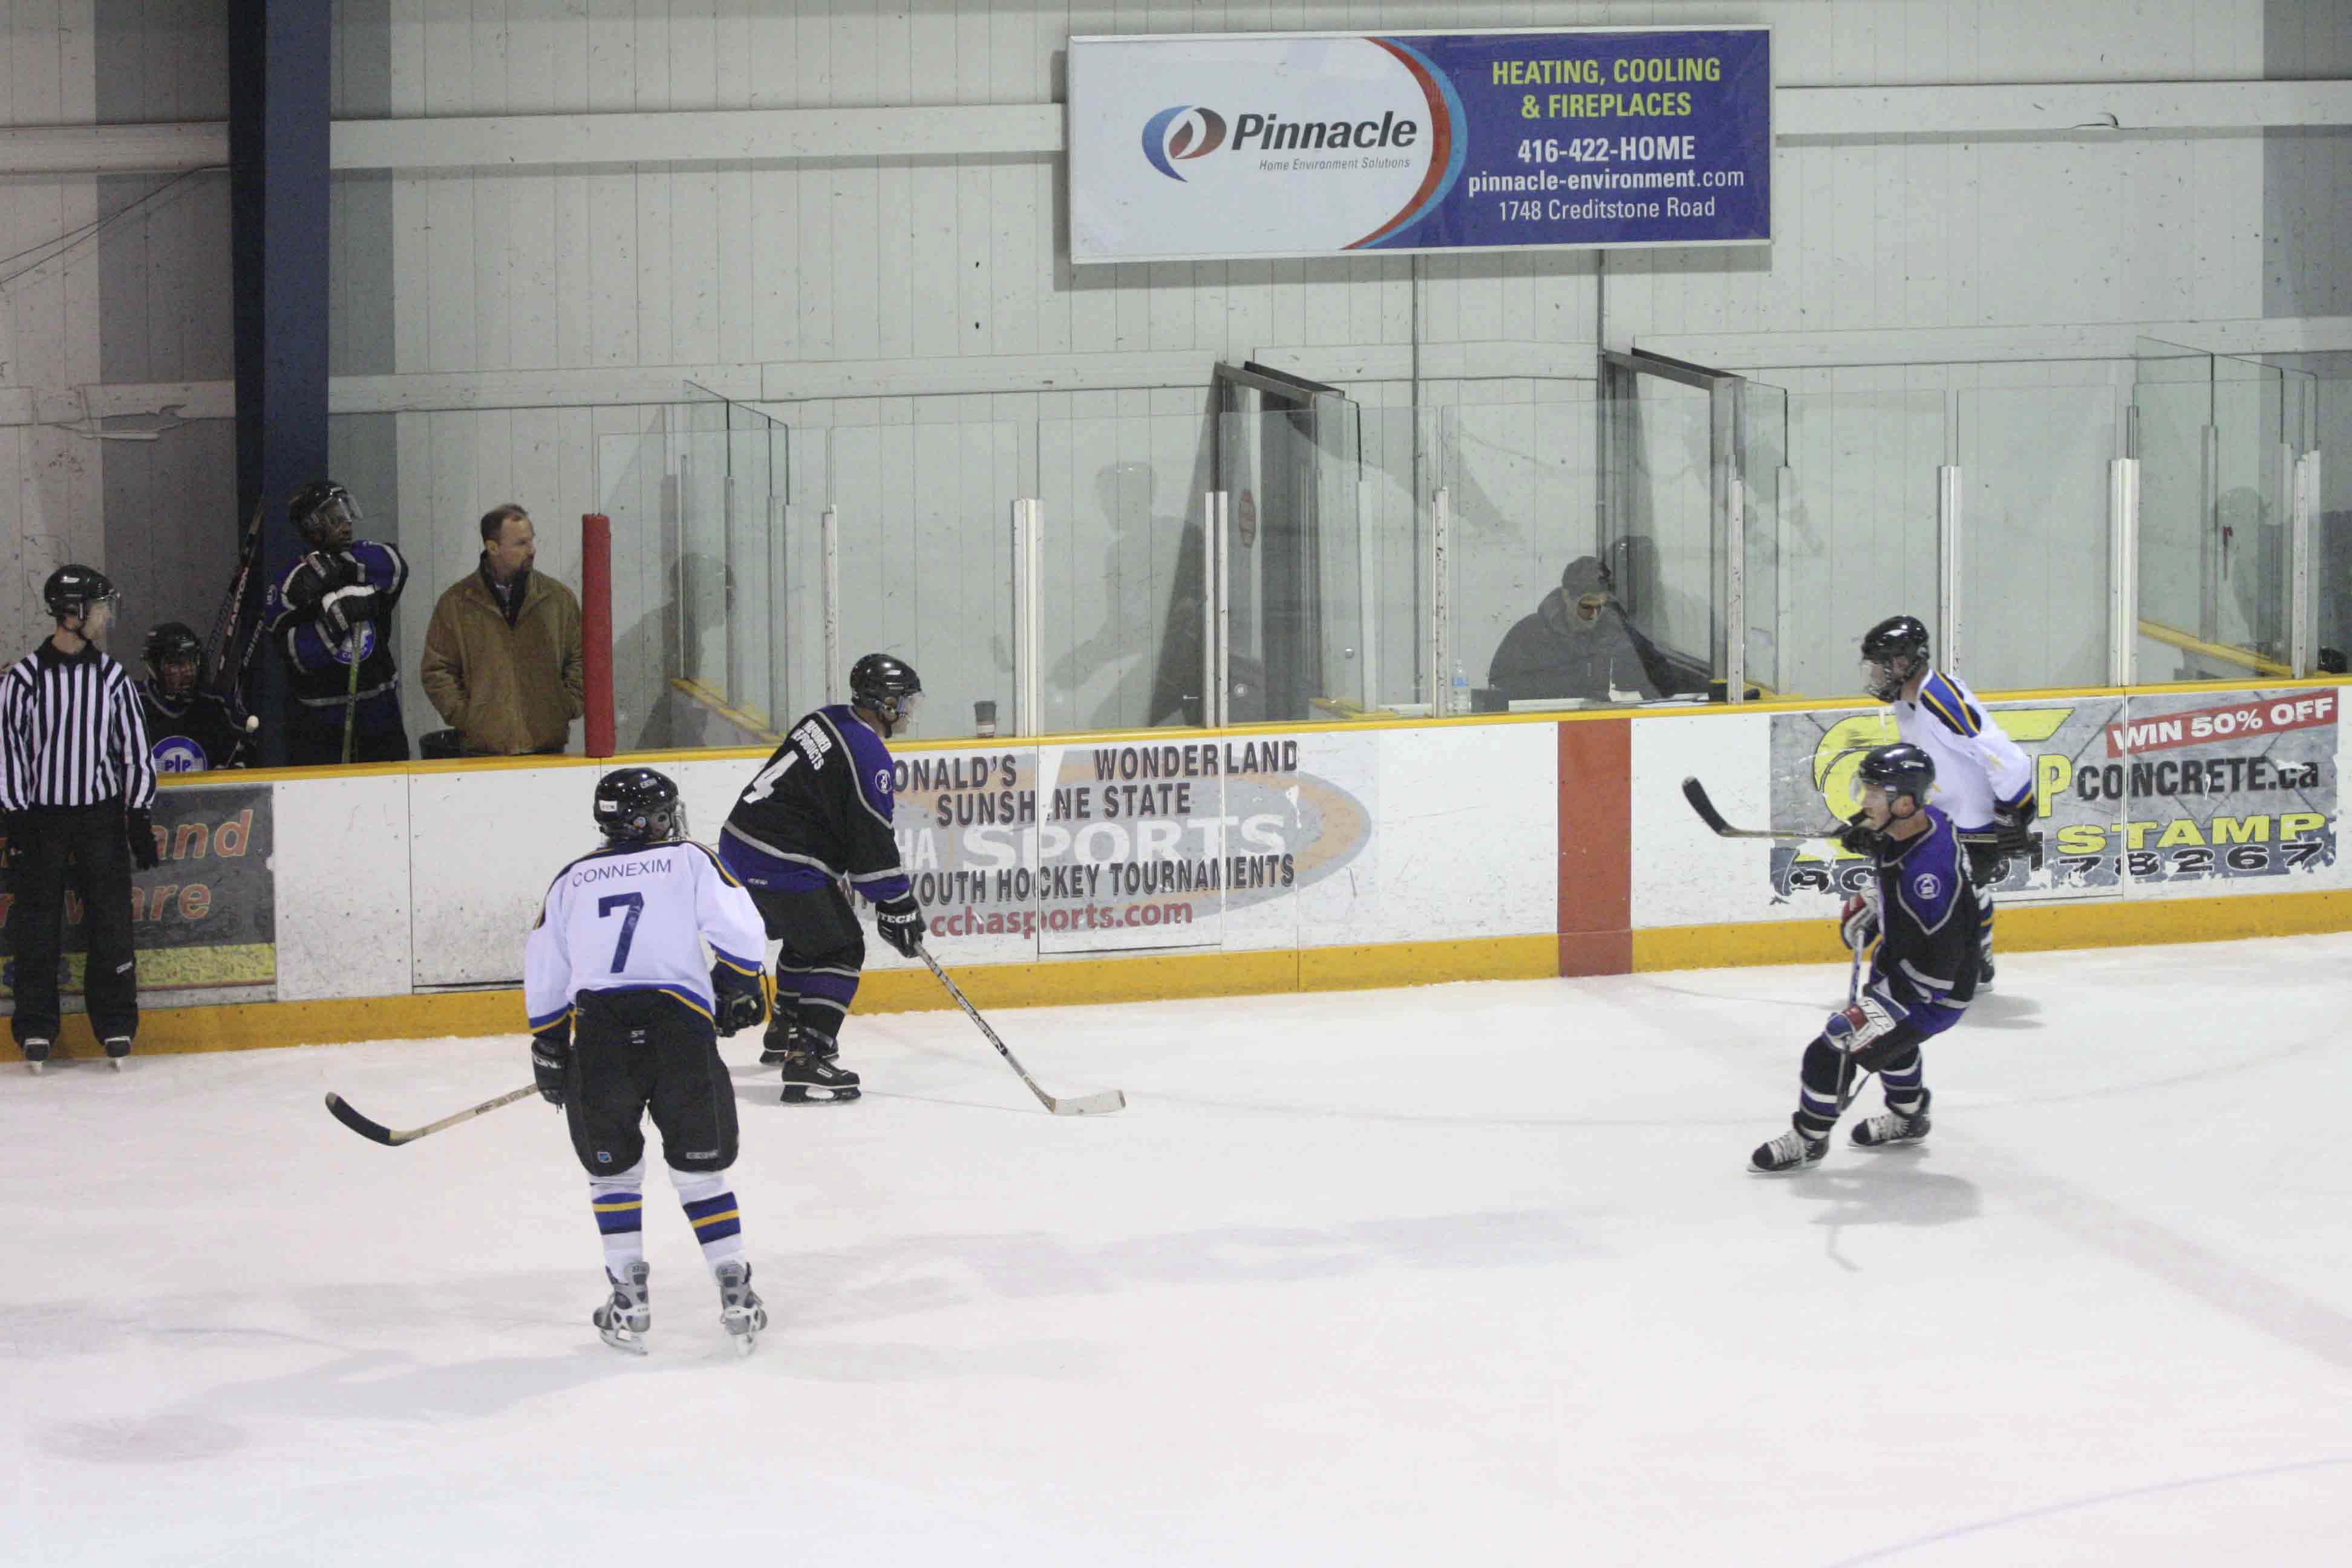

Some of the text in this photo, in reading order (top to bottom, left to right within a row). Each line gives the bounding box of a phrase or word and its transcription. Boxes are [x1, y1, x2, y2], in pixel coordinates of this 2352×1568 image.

[1492, 57, 1720, 86] HEATING, COOLING
[1521, 91, 1692, 119] & FIREPLACES
[1231, 110, 1417, 151] Pinnacle
[1517, 135, 1696, 163] 416-422-HOME
[1259, 155, 1411, 171] Home Environment Solutions
[1468, 168, 1745, 198] pinnacle-environment.com
[1499, 196, 1716, 221] 1748 Creditstone Road
[2112, 697, 2334, 750] WIN 50% OFF
[893, 740, 1298, 793] ONALD'S WONDERLAND
[2077, 756, 2319, 801] CONCRETE.ca
[936, 782, 1191, 828] SUNSHNE STATE
[962, 814, 1287, 872] SPORTS
[2057, 812, 2326, 855] STAMP
[572, 858, 672, 887] CONNEXIM
[997, 863, 1100, 902] HOCKEY
[1109, 854, 1295, 895] TOURNAMENTS
[598, 891, 645, 974] 7
[929, 902, 1193, 939] cchasports.com
